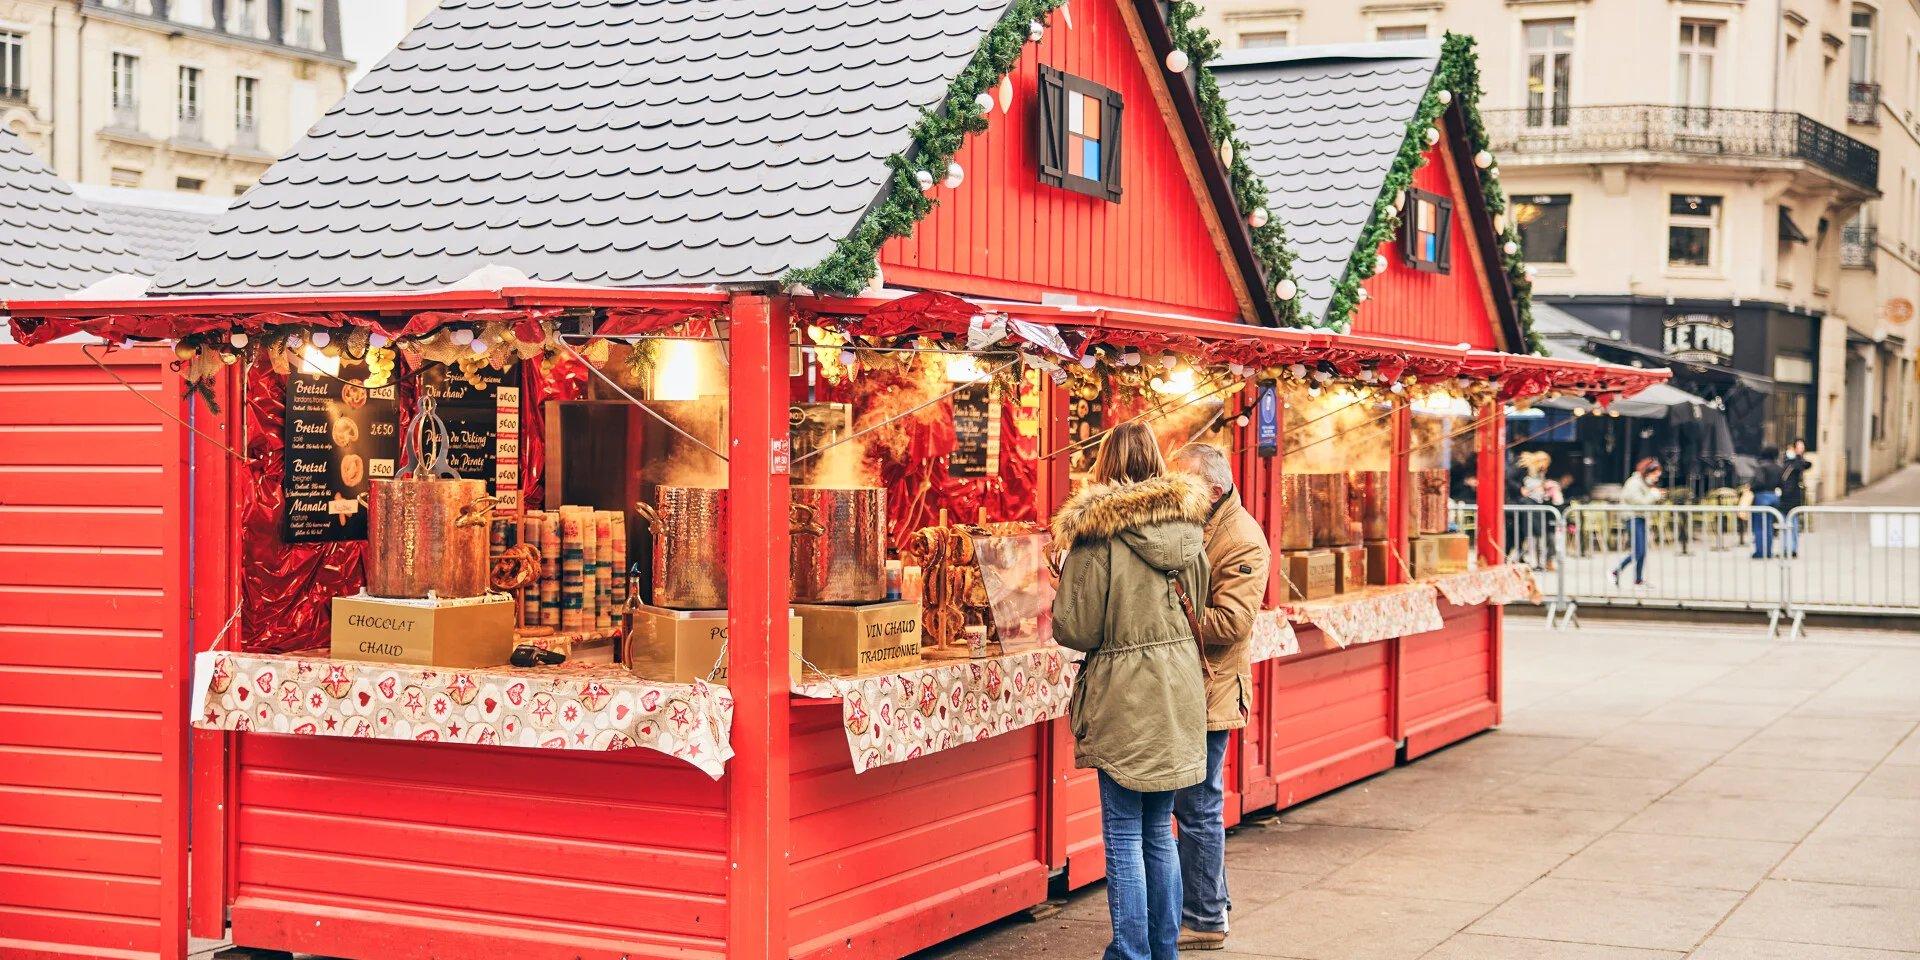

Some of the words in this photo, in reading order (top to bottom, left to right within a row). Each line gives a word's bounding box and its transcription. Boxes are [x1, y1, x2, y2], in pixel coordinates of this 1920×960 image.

[1664, 325, 1692, 355] LE
[1694, 324, 1734, 356] PUB
[294, 380, 329, 395] Bretzel
[425, 384, 441, 398] Vin
[499, 392, 517, 403] 4€00
[293, 419, 328, 434] Bretzel
[370, 423, 394, 436] 2€50
[498, 418, 517, 429] 5€00
[498, 443, 516, 454] 5€00
[292, 459, 328, 473] Bretzel
[371, 463, 392, 475] 3€00
[498, 469, 516, 480] 4€00
[289, 498, 328, 515] Manala
[348, 614, 416, 632] CHOCOLAT
[866, 622, 883, 638] VIN
[885, 619, 916, 636] CHAUD
[359, 641, 404, 657] CHAUD
[860, 643, 920, 664] TRADITIONNEL
